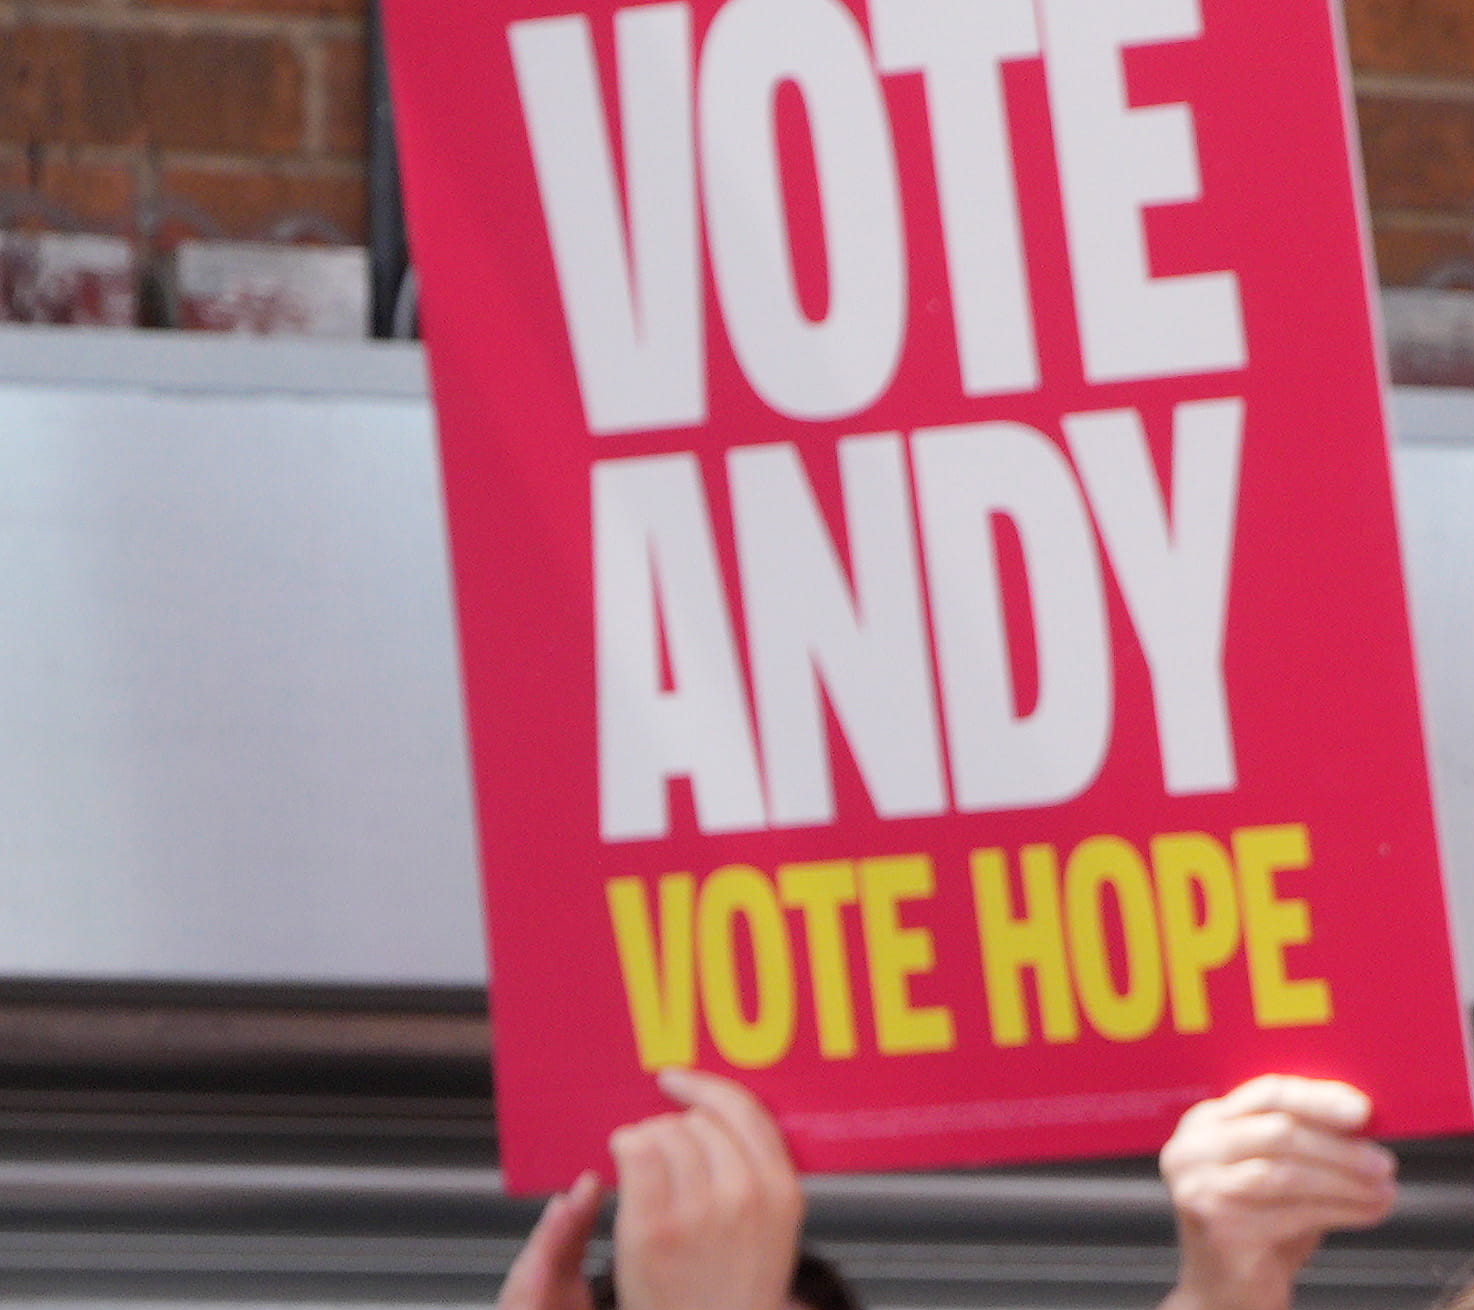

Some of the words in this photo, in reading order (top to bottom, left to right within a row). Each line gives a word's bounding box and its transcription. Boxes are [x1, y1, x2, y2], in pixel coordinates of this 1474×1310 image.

[507, 0, 1248, 435] VOTE
[590, 396, 1247, 843] ANDY
[606, 855, 955, 1072] VOTE
[970, 824, 1333, 1050] HOPE
